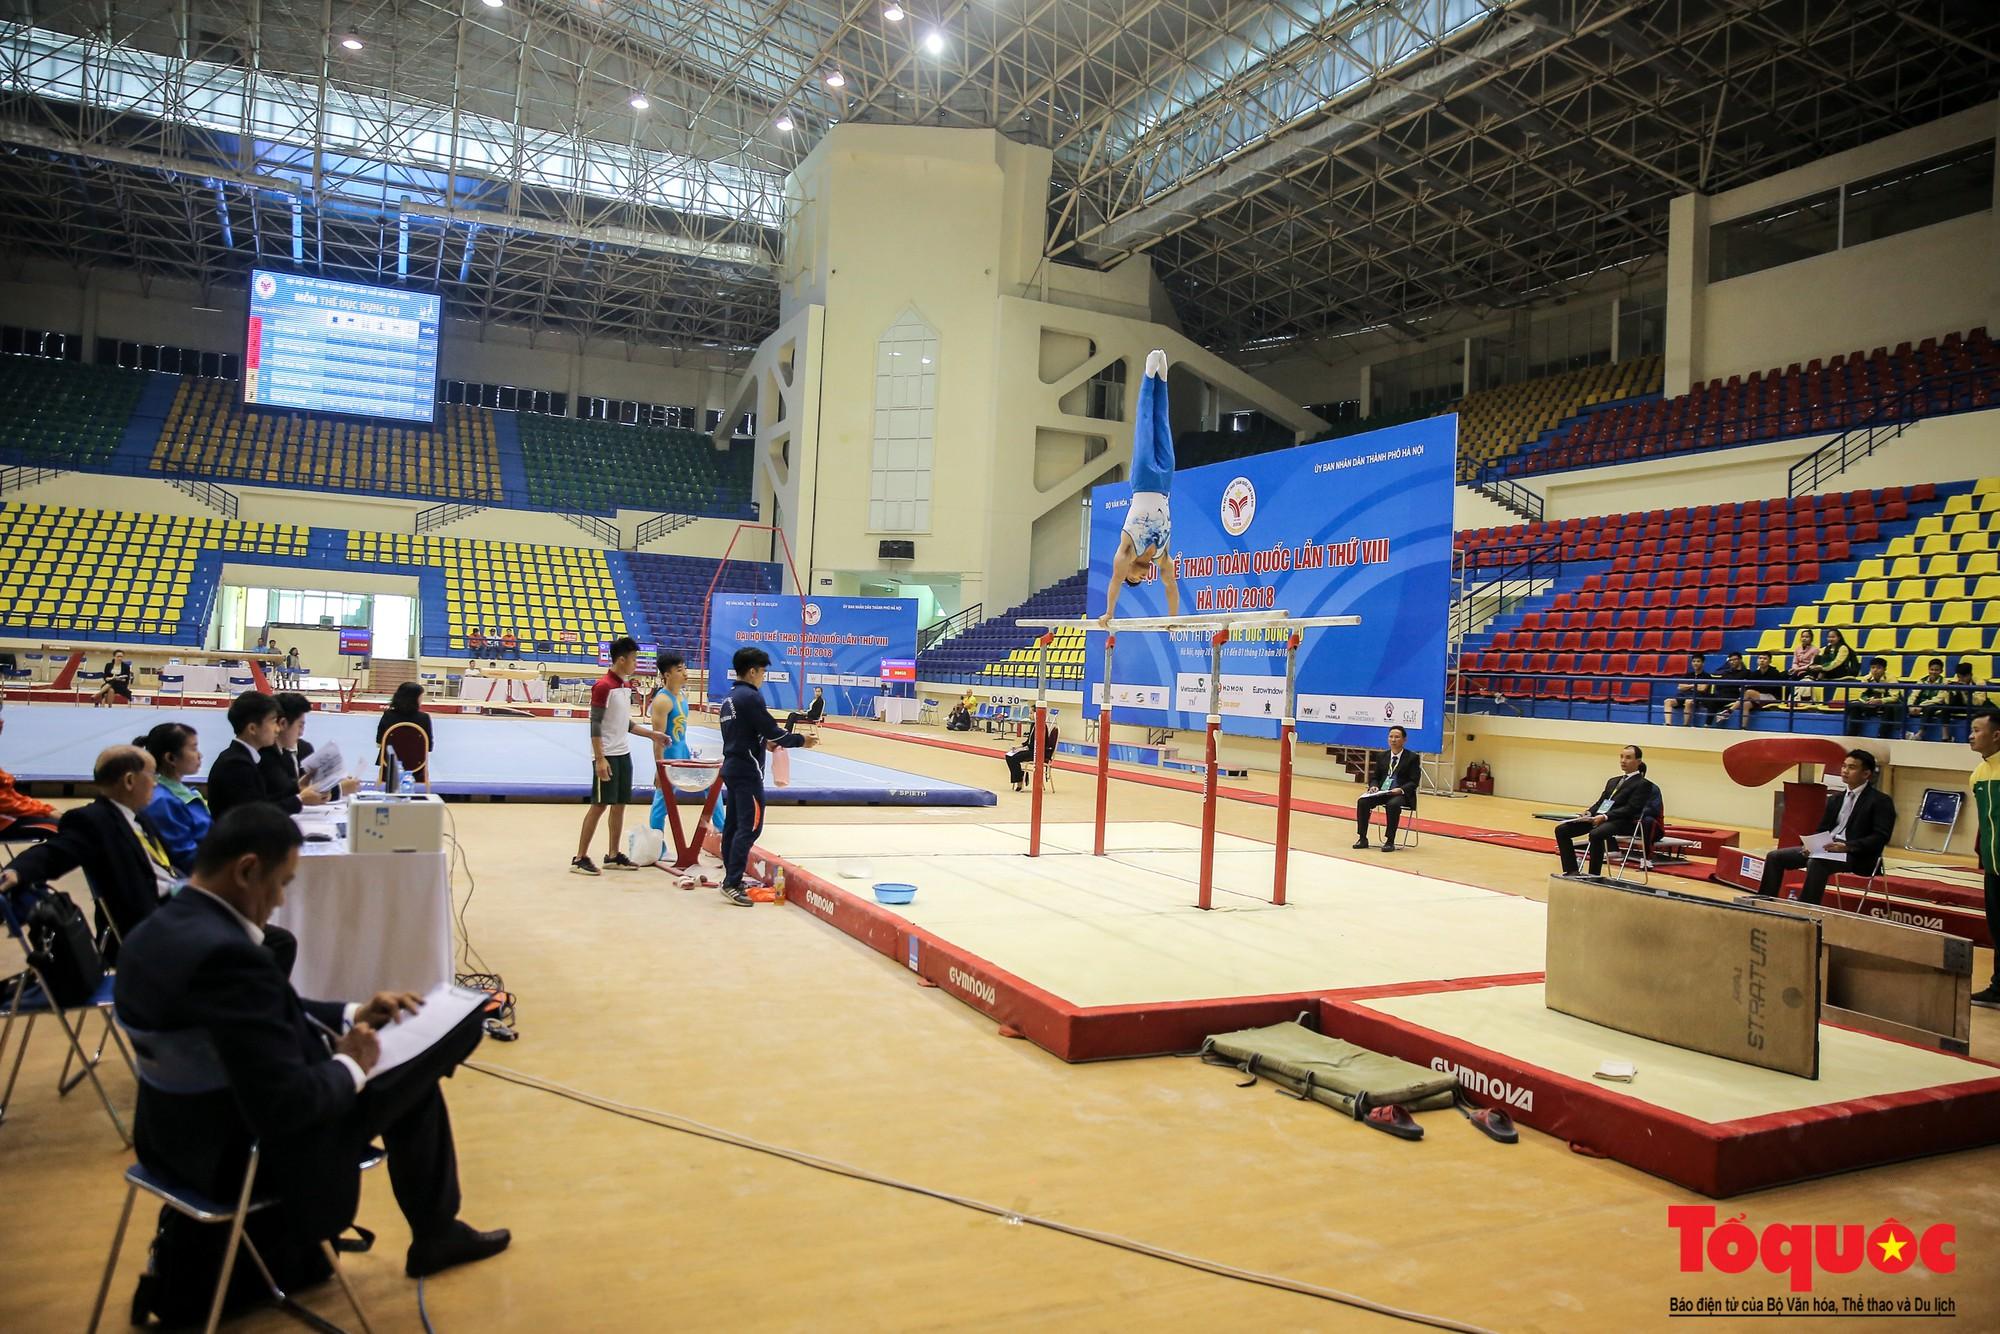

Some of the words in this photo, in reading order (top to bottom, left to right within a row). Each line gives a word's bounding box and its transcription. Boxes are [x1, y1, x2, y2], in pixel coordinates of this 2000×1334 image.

[1322, 461, 1336, 473] BAN
[1335, 458, 1352, 470] NHÂN
[1352, 455, 1365, 467] DÂN
[1365, 452, 1387, 465] THÀNH
[1387, 447, 1401, 460] PHỐ
[1401, 445, 1411, 457] HÀ
[1412, 444, 1424, 457] NỘI
[1184, 556, 1214, 579] THAO
[1216, 549, 1251, 576] TOÀN
[1253, 542, 1291, 575] QUỐC
[1294, 539, 1324, 571] LẦN
[1327, 537, 1361, 568] THỨ
[1362, 538, 1389, 565] VIII
[1196, 586, 1214, 611] HÀ
[1216, 584, 1240, 613] NỘI
[1241, 586, 1274, 609] 2018
[736, 631, 749, 642] ĐẠI
[749, 631, 762, 642] HỘI
[763, 629, 777, 642] THỂ
[779, 633, 798, 643] THAO
[799, 632, 819, 644] TOÀN
[820, 631, 841, 645] QUỐC
[842, 633, 858, 646] LẦN
[859, 634, 875, 646] THỨ
[875, 637, 888, 646] VIII
[787, 645, 798, 656] HÀ
[799, 647, 813, 658] NỘI
[814, 648, 832, 658] 2018
[1007, 696, 1020, 705] 30
[1252, 686, 1283, 695] Eurowindow
[806, 889, 834, 916] GYMNOVA
[1870, 907, 1944, 930] GYMNOVA
[949, 966, 996, 1006] GYMNOVA
[1747, 927, 1768, 1051] STRATUM
[1430, 1056, 1534, 1113] GYMNOVA
